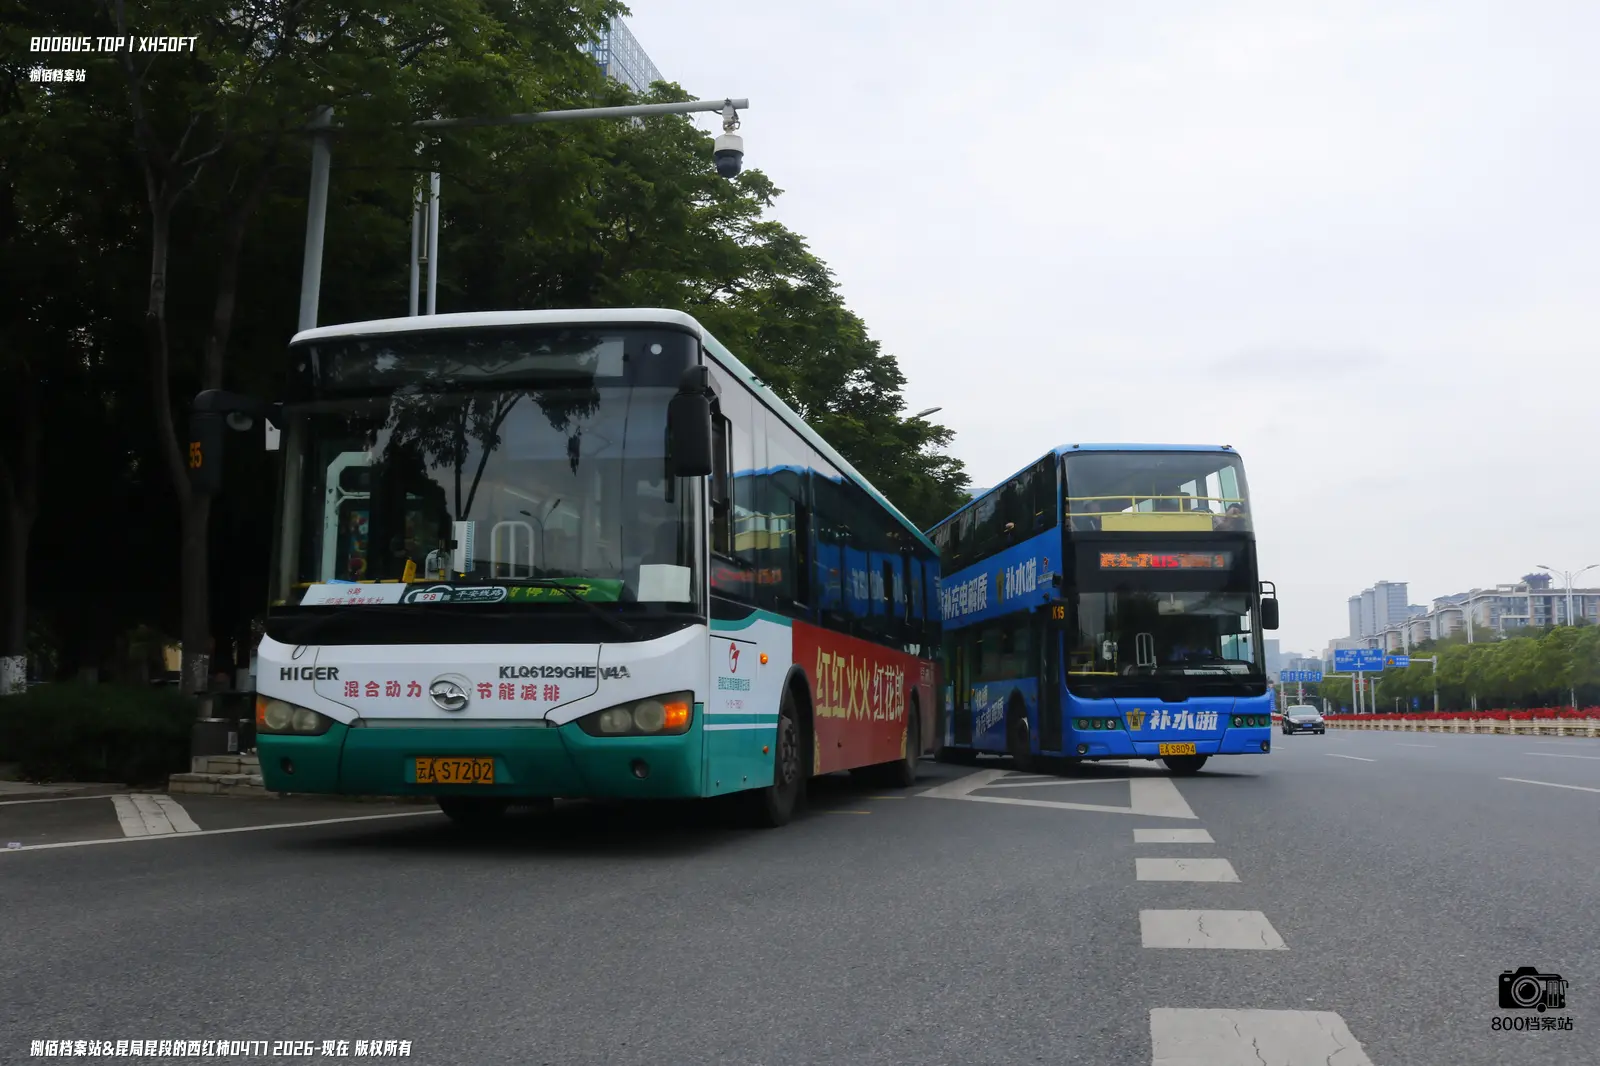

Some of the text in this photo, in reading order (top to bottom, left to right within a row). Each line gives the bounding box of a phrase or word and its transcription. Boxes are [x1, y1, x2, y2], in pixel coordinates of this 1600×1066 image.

[940, 572, 988, 621] 补充电解质
[1005, 557, 1037, 600] 补水啦
[1052, 605, 1065, 620] K15
[279, 666, 340, 681] HIGER
[815, 646, 905, 722] 红红火火 红花郎
[343, 680, 561, 702] 混合动力 节能减排
[1149, 709, 1218, 731] 补水啦
